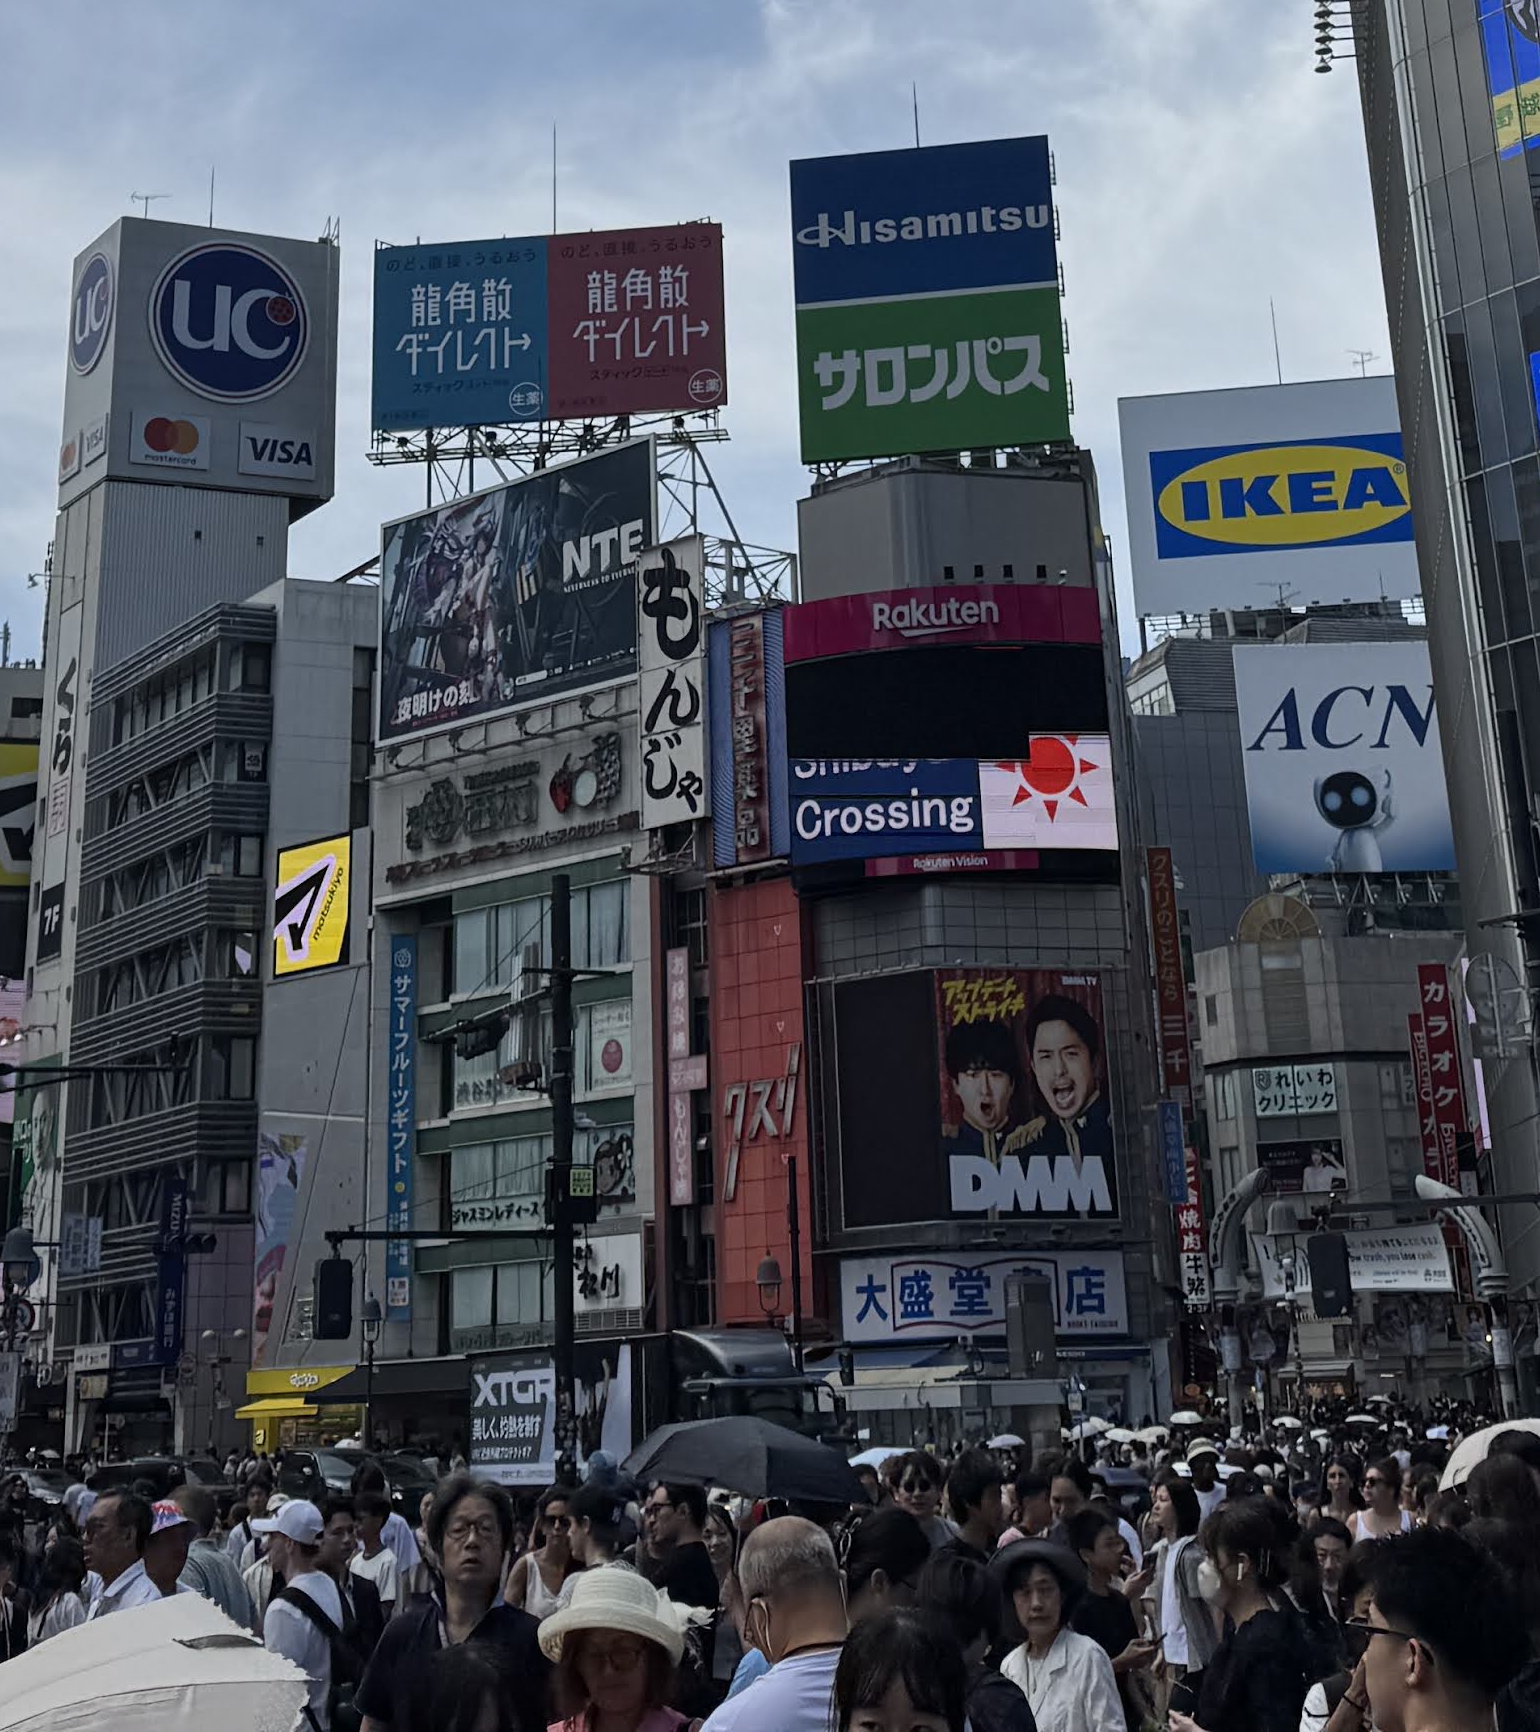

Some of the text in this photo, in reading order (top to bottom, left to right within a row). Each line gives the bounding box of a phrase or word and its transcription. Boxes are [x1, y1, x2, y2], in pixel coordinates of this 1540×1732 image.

[796, 204, 1049, 248] Hisamitsu
[411, 277, 513, 328] 龍角散
[586, 264, 690, 314] 龍角散
[172, 279, 298, 360] UC
[572, 313, 710, 363] ダイレクト
[395, 326, 532, 376] ダイレクト
[814, 335, 1050, 410] サロンパス
[246, 435, 313, 466] VISA
[1181, 465, 1408, 522] IKEA
[872, 598, 999, 632] Rakuten
[642, 548, 703, 813] もんじゃ
[796, 788, 975, 840] Crossing
[957, 854, 989, 869] Vision
[43, 905, 61, 935] 7F
[313, 867, 344, 940] matsukiyo
[1086, 976, 1097, 986] TV
[1153, 856, 1188, 1074] クスリのことなら三千
[1423, 981, 1459, 1108] カラオケ
[388, 974, 412, 1173] サマーフルーツギフト
[1275, 1068, 1333, 1088] れいわ
[1258, 1092, 1334, 1112] クリニック
[950, 1155, 1113, 1212] DMM
[451, 1201, 545, 1225] ジャスミンレディース
[856, 1266, 1107, 1324] 大盛堂店
